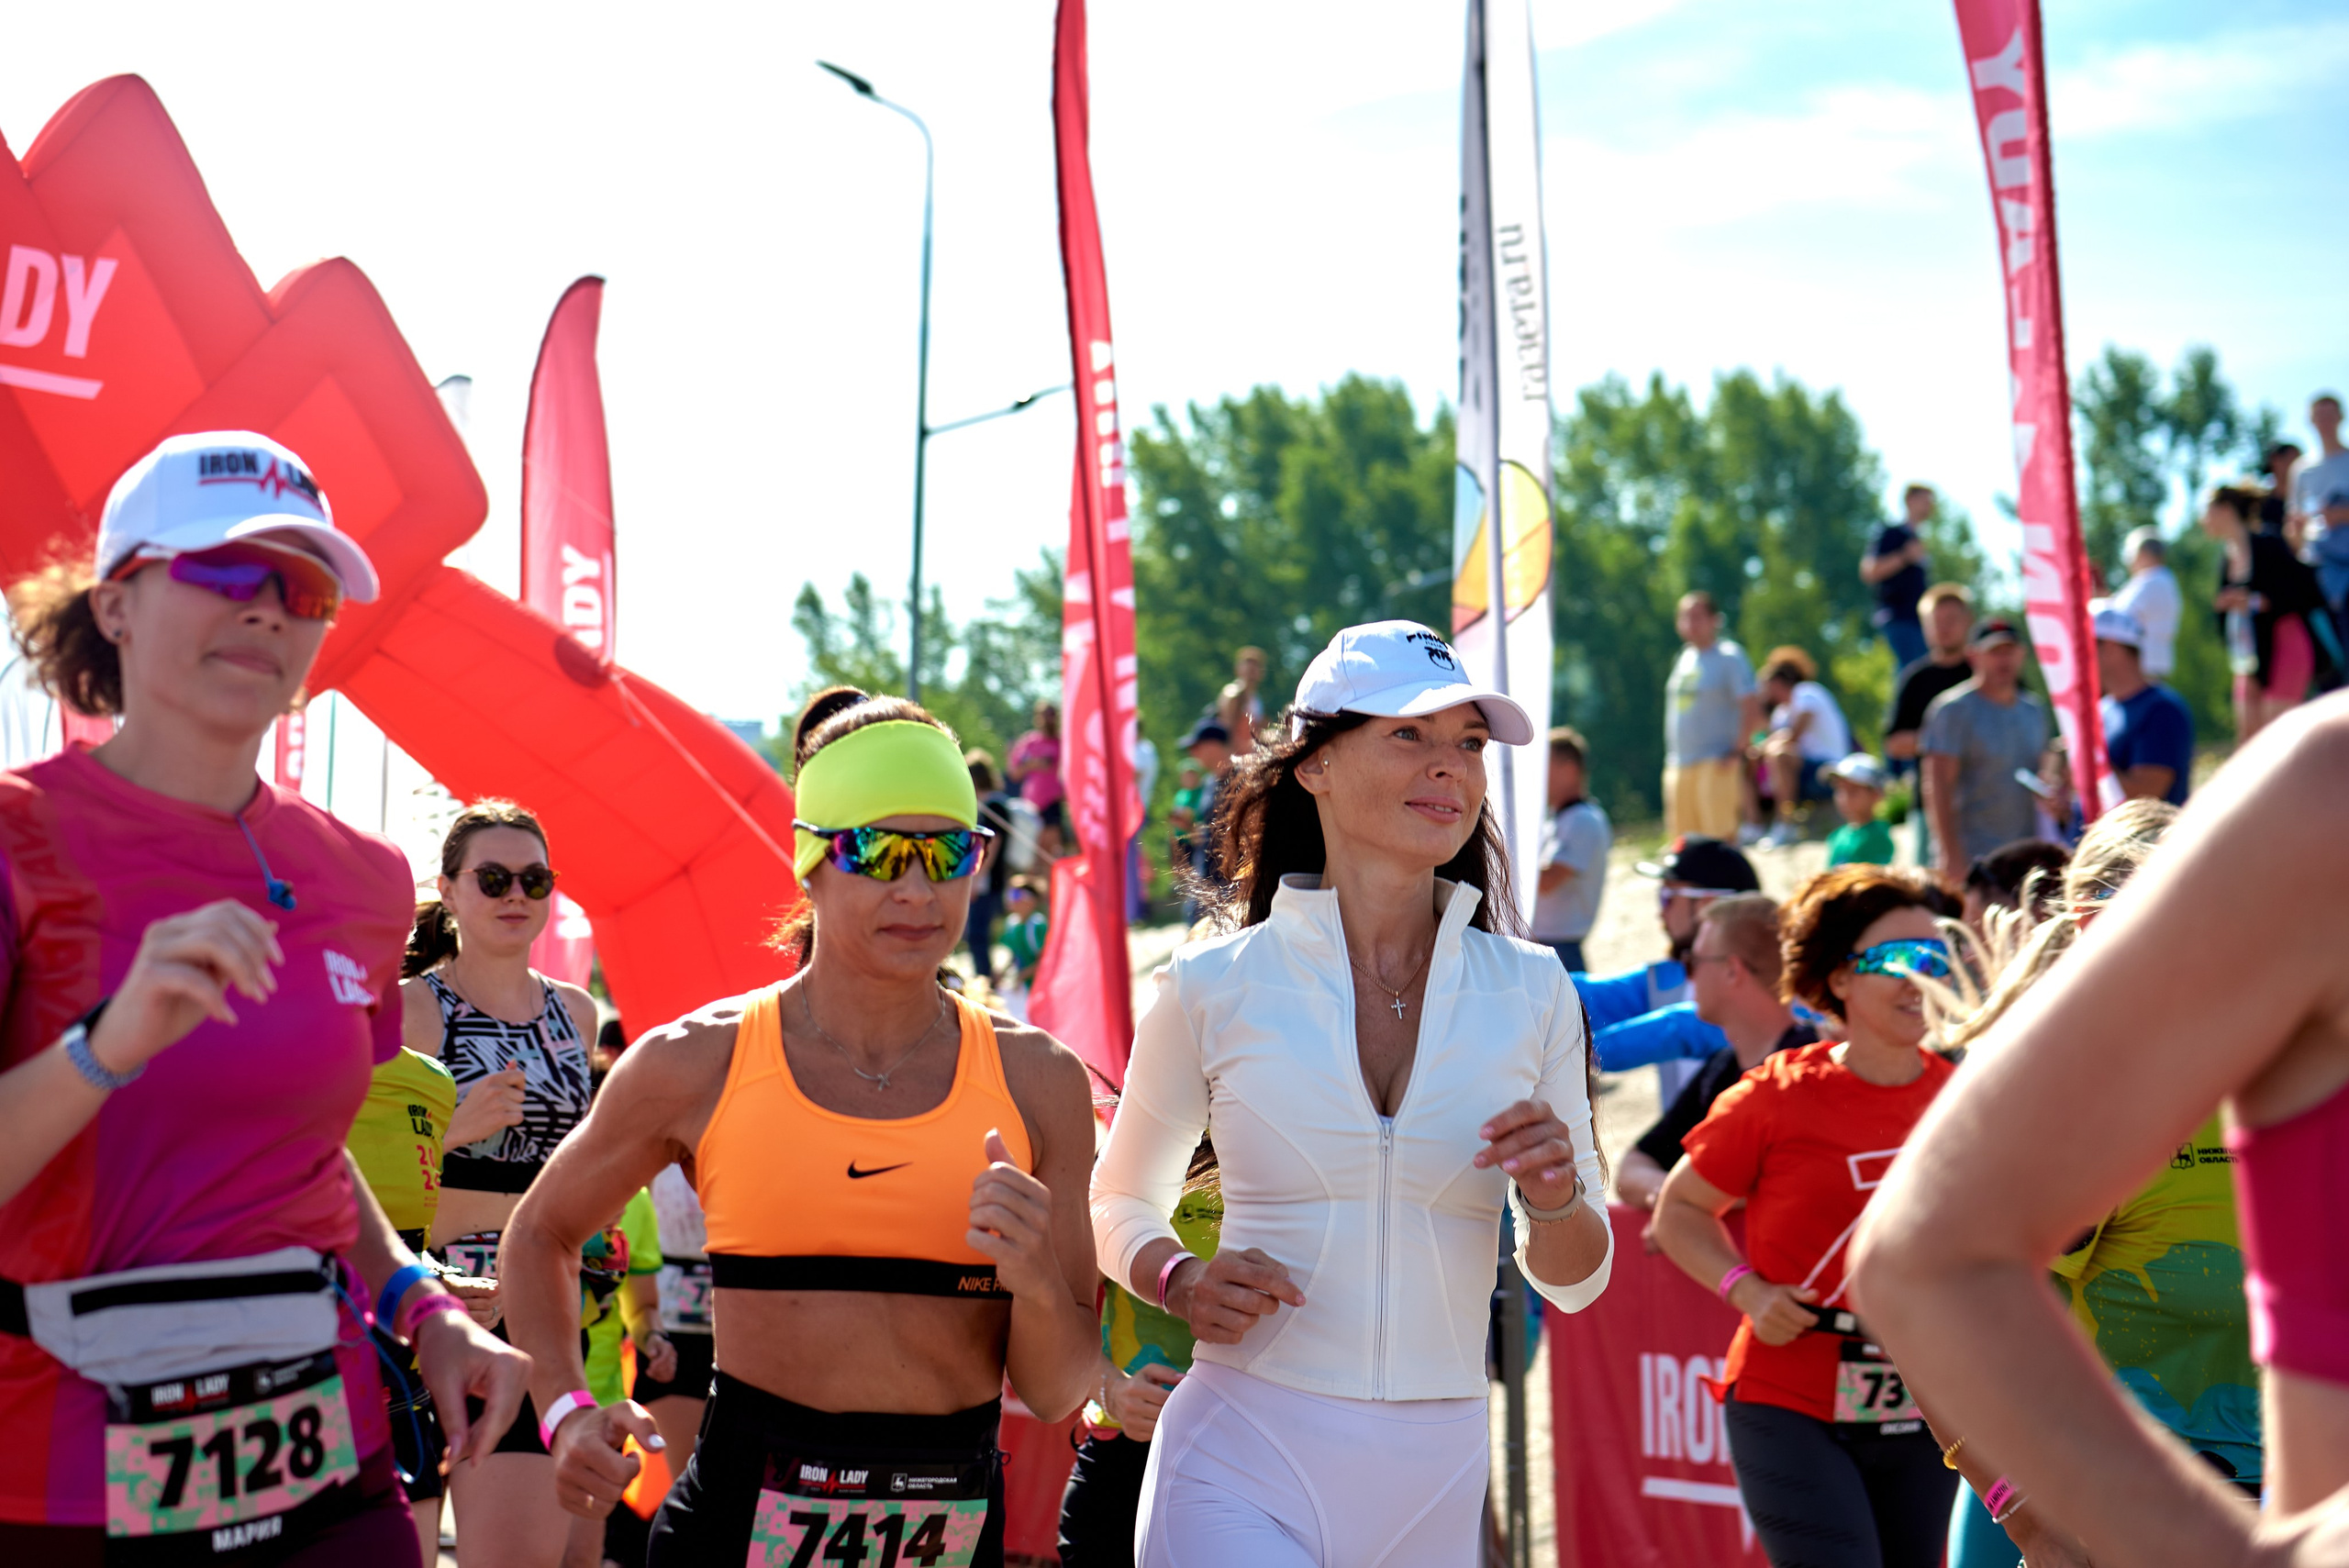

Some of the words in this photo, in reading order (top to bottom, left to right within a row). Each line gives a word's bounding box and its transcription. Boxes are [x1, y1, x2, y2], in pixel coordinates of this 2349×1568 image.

[199, 450, 259, 476] IRON
[408, 1104, 429, 1118] IRON
[958, 1276, 992, 1292] NIKE
[150, 1383, 184, 1405] IRON
[195, 1373, 229, 1398] LADY
[150, 1405, 325, 1509] 7128
[799, 1463, 828, 1483] IRON
[840, 1470, 869, 1485] LADY
[212, 1516, 283, 1552] МАРИЯ
[788, 1509, 949, 1568] 7414
